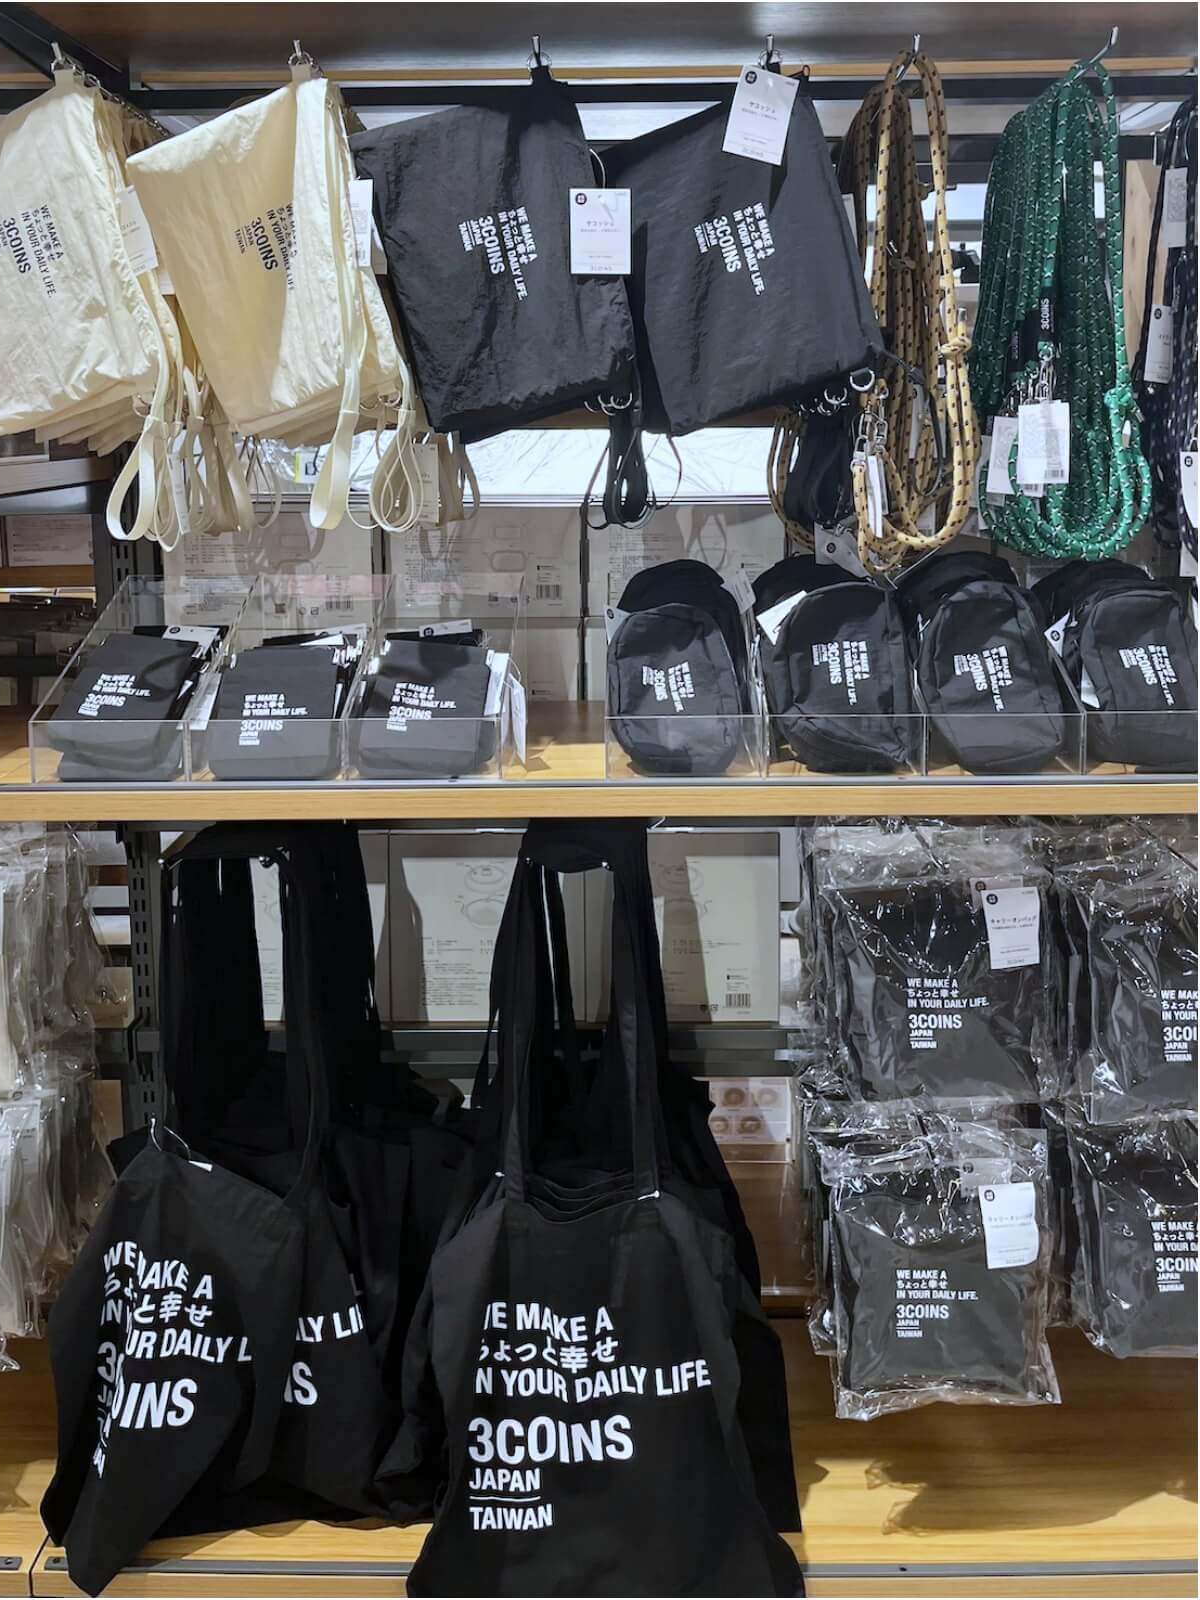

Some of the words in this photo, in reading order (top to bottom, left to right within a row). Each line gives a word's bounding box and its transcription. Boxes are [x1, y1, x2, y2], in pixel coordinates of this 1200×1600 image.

[21, 211, 31, 222] IN
[498, 211, 508, 223] IN
[516, 206, 528, 223] WE
[733, 210, 744, 221] IN
[753, 202, 765, 219] WE
[25, 222, 40, 249] YOUR
[40, 204, 51, 221] WE
[47, 222, 63, 253] MAKE
[55, 251, 65, 260] A
[267, 209, 277, 220] IN
[272, 221, 285, 246] YOUR
[471, 219, 483, 245] JAPAN
[501, 223, 514, 249] YOUR
[521, 224, 536, 253] MAKE
[705, 221, 717, 246] JAPAN
[737, 221, 751, 247] YOUR
[758, 219, 774, 247] MAKE
[2, 217, 31, 274] 3COINS
[251, 216, 278, 271] 3COINS
[479, 216, 505, 274] 3COINS
[713, 215, 741, 273] 3COINS
[766, 247, 775, 256] A
[34, 249, 50, 274] DAILY
[507, 249, 522, 276] DAILY
[528, 253, 538, 262] A
[744, 246, 759, 272] DAILY
[1040, 298, 1050, 330] 3COINS
[828, 641, 842, 684] 3COINS
[967, 653, 988, 691] 3COINS
[1133, 647, 1158, 685] 3COINS
[85, 693, 126, 707] 3COINS
[389, 705, 432, 720] 3COINS
[240, 720, 283, 731] 3COINS
[907, 978, 921, 988] WE
[923, 978, 950, 988] MAKE
[951, 979, 958, 988] A
[1161, 990, 1176, 1000] WE
[907, 998, 918, 1008] IN
[919, 998, 943, 1009] YOUR
[943, 998, 968, 1008] DAILY
[1161, 1010, 1172, 1021] IN
[1174, 1010, 1198, 1020] YOUR
[908, 1013, 963, 1029] 3COINS
[909, 1029, 934, 1037] JAPAN
[1151, 1222, 1166, 1231] WE
[1168, 1222, 1194, 1231] MAKE
[1154, 1242, 1164, 1251] IN
[1166, 1242, 1190, 1252] YOUR
[104, 1241, 138, 1273] WE
[192, 1275, 213, 1300] A
[896, 1269, 911, 1279] WE
[912, 1269, 939, 1279] MAKE
[940, 1269, 948, 1279] A
[896, 1290, 906, 1299] IN
[907, 1290, 931, 1299] YOUR
[932, 1290, 957, 1300] DAILY
[484, 1302, 508, 1330] E
[515, 1302, 588, 1343] MAKE
[594, 1306, 614, 1334] A
[896, 1304, 950, 1319] 3COINS
[100, 1299, 123, 1327] IN
[159, 1327, 234, 1363] DAILY
[475, 1367, 493, 1395] N
[501, 1367, 569, 1403] YOUR
[574, 1365, 648, 1404] DAILY
[468, 1414, 635, 1466] 3COINS
[469, 1467, 542, 1493] JAPAN
[469, 1503, 554, 1531] TAIWAN
